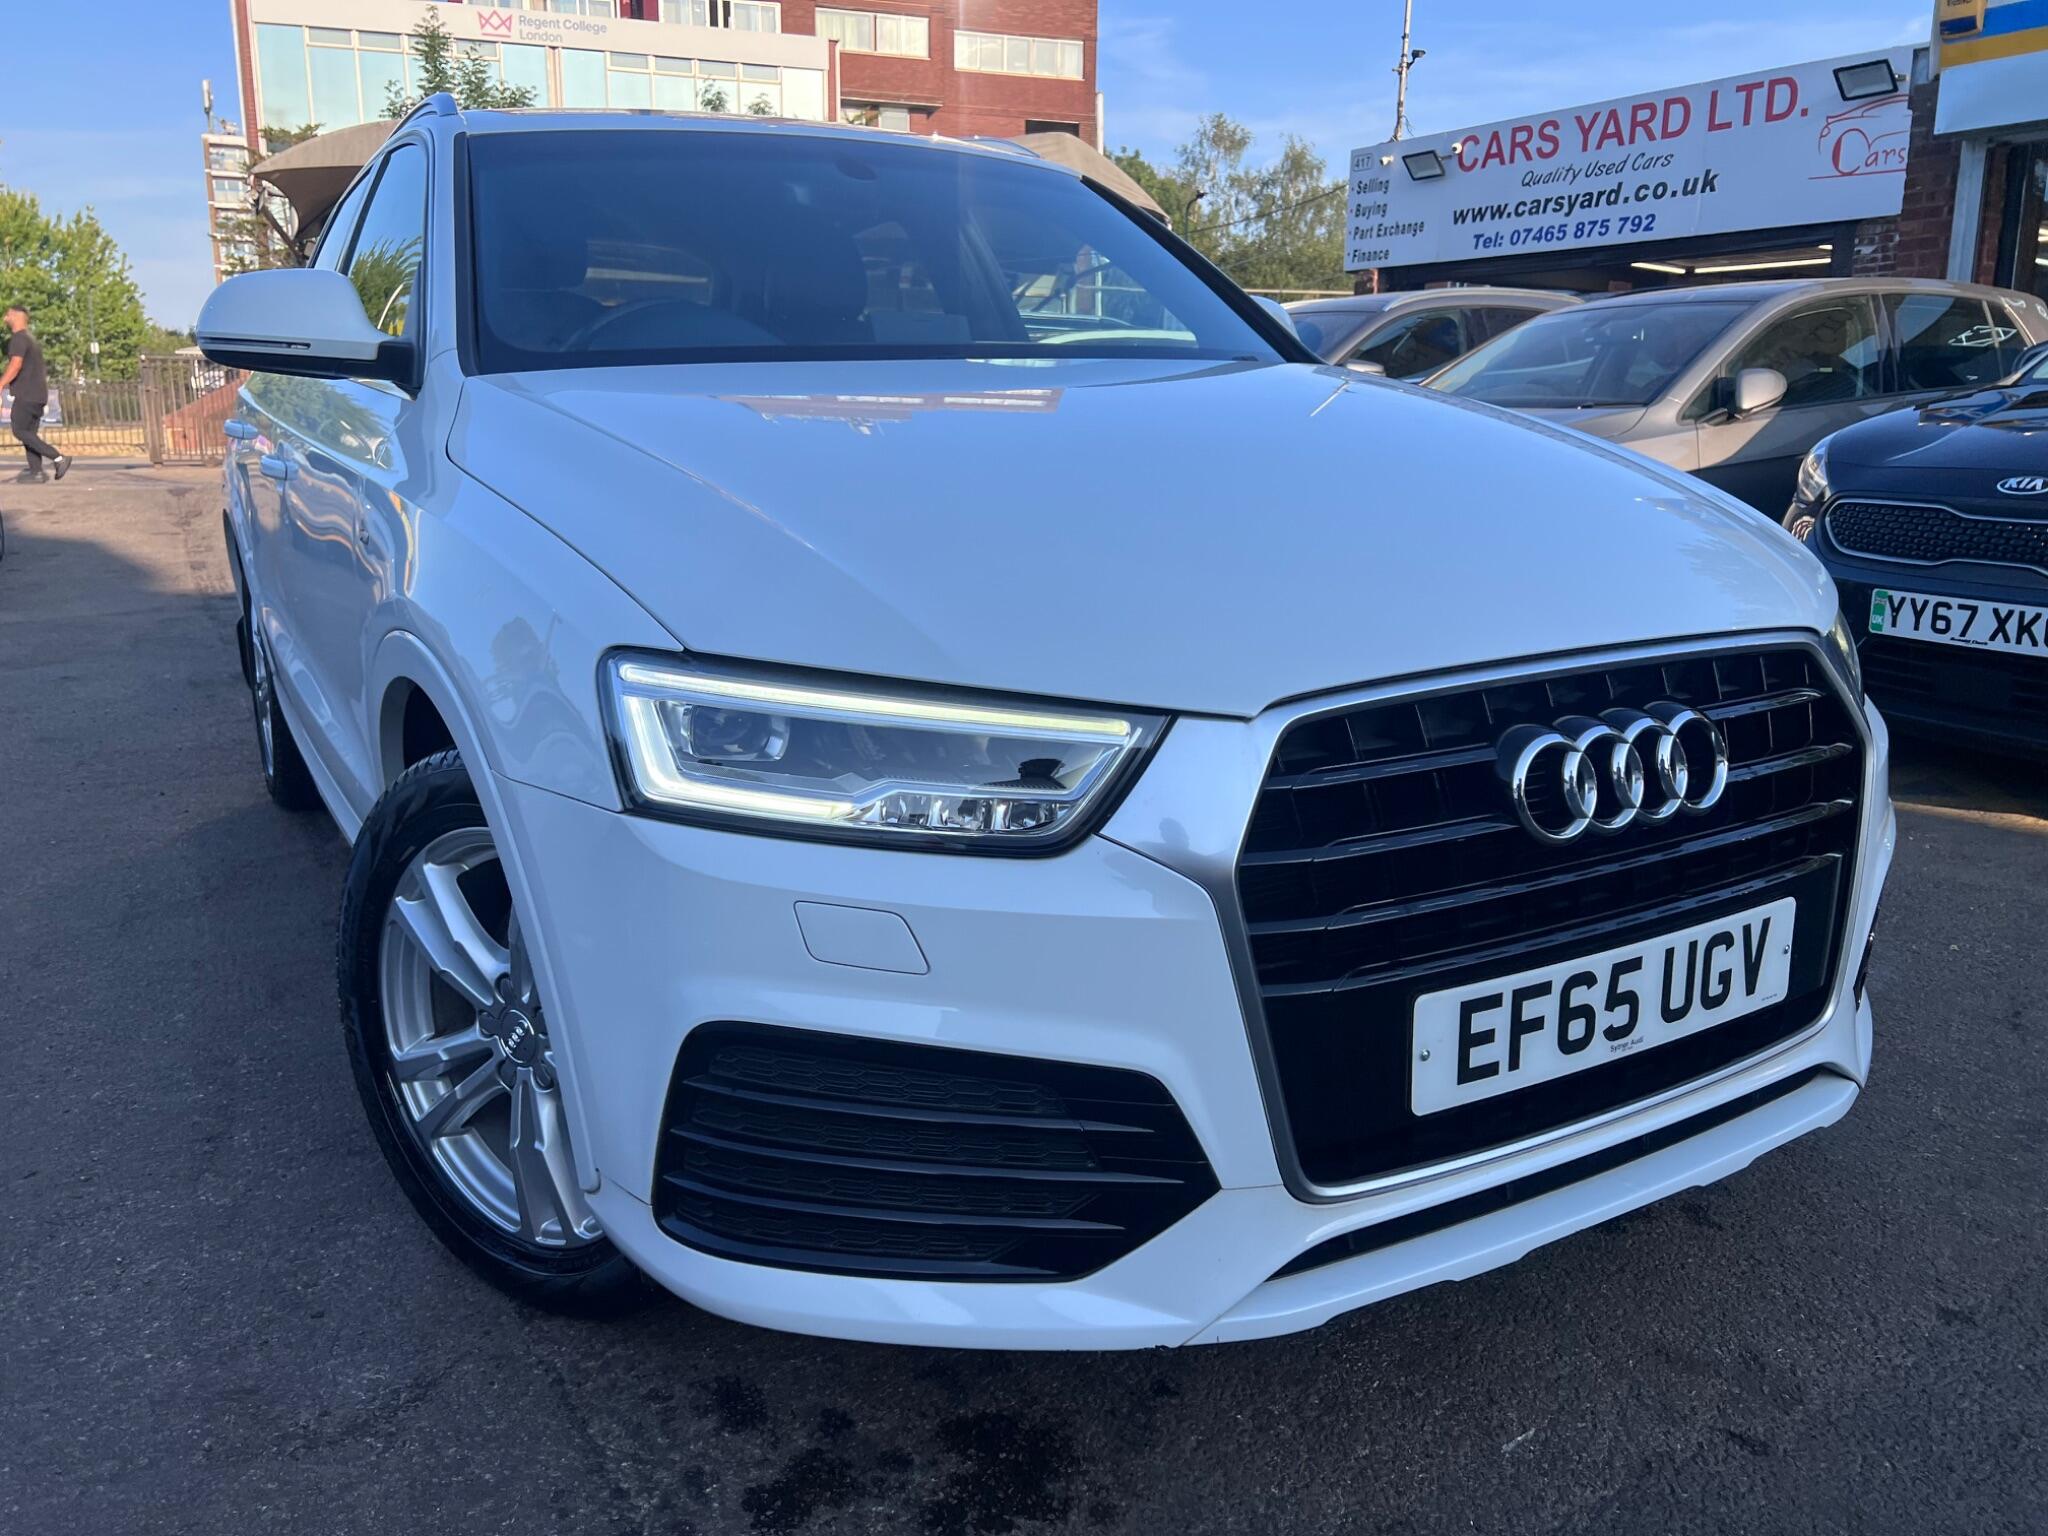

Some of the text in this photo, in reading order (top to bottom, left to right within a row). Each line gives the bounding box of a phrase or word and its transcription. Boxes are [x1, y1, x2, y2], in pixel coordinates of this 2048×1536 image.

[518, 14, 608, 36] Regent College
[519, 29, 563, 43] London
[1458, 76, 1809, 173] CARS YARD LTD.
[1354, 156, 1371, 169] 417
[1832, 127, 1907, 176] Cars
[1521, 152, 1675, 188] Quality Used Cars
[1356, 179, 1390, 195] Selling
[1452, 168, 1720, 226] www.carsyard.co.uk
[1354, 202, 1388, 220] Buying
[1353, 220, 1425, 241] Part Exchange
[1473, 213, 1657, 250] Tel: 07465 875 792
[1352, 248, 1390, 263] Finance
[2003, 477, 2044, 491] KIA
[1887, 594, 2048, 650] YY67 XK
[1456, 916, 1772, 1086] EF65 UGV
